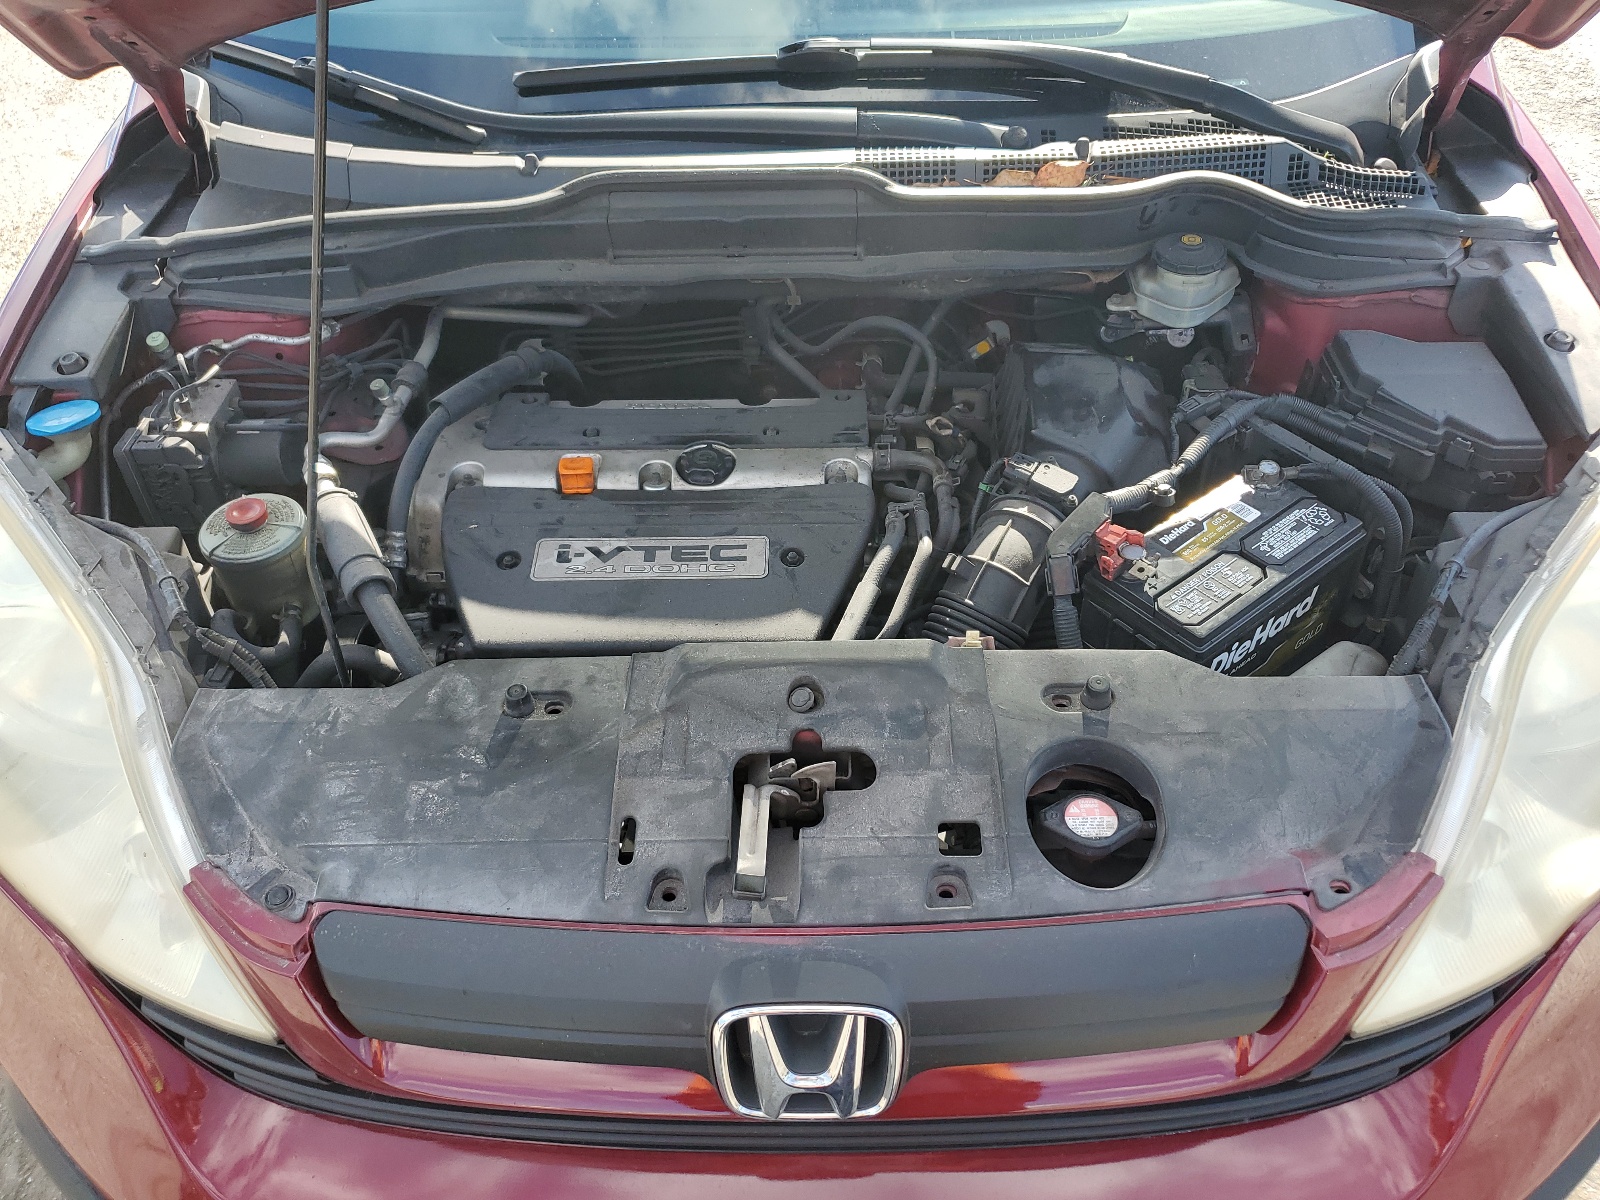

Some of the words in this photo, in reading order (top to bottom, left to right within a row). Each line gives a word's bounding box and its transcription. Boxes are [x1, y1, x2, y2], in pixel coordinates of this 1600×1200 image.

[1158, 519, 1196, 545] DieHard
[1211, 513, 1229, 527] GOLD
[555, 543, 748, 564] i-VTEC
[564, 564, 616, 575] 2.4
[623, 563, 736, 574] DOHC
[1174, 577, 1201, 598] DANGER
[1203, 561, 1226, 579] POISON
[1210, 584, 1320, 673] DieHard
[1294, 622, 1324, 650] GOLD
[1229, 652, 1257, 676] AHEAD
